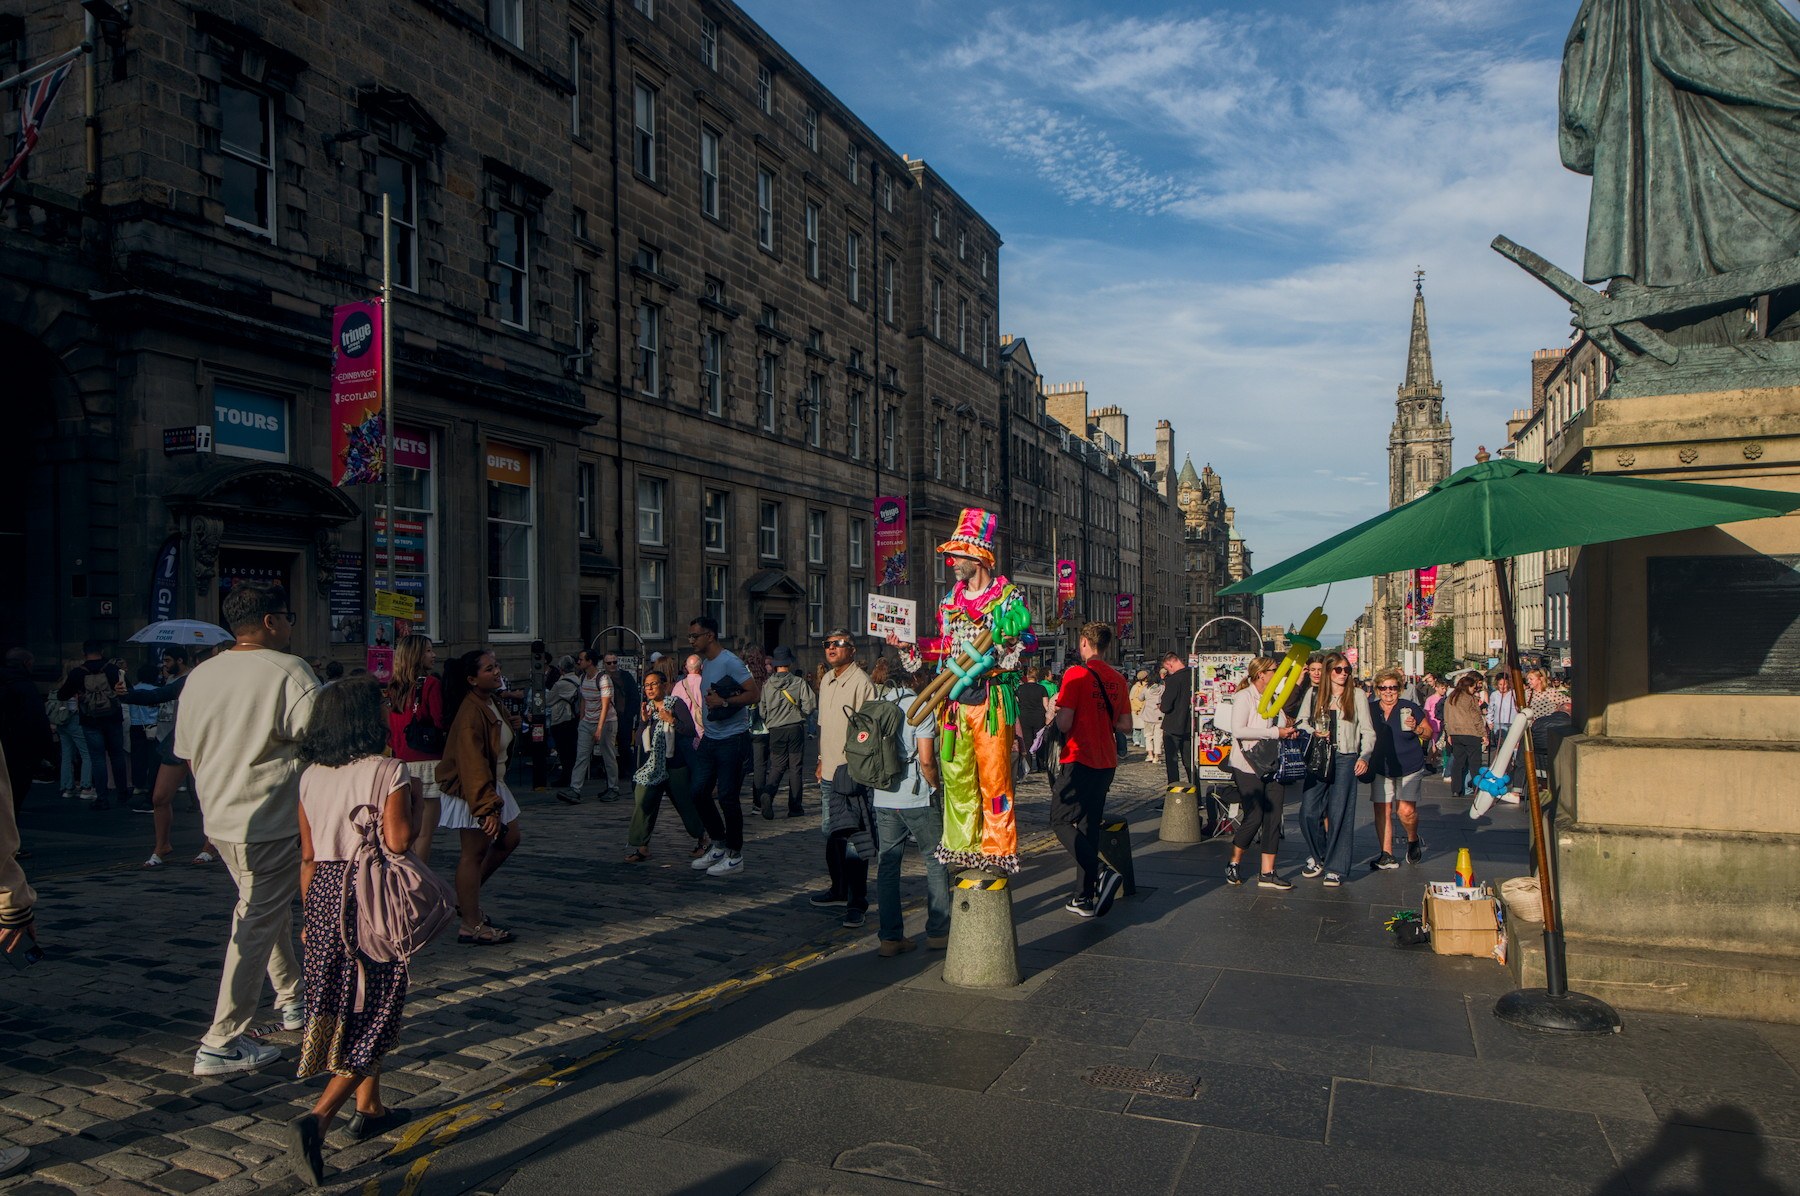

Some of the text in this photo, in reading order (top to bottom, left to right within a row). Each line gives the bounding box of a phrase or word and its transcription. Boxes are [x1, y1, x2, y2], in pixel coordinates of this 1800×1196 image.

[341, 323, 372, 347] fringe
[341, 391, 377, 403] SCOTLAND
[214, 406, 279, 432] TOURS
[487, 454, 521, 472] GIFTS
[880, 507, 899, 518] fringe
[102, 602, 111, 611] G
